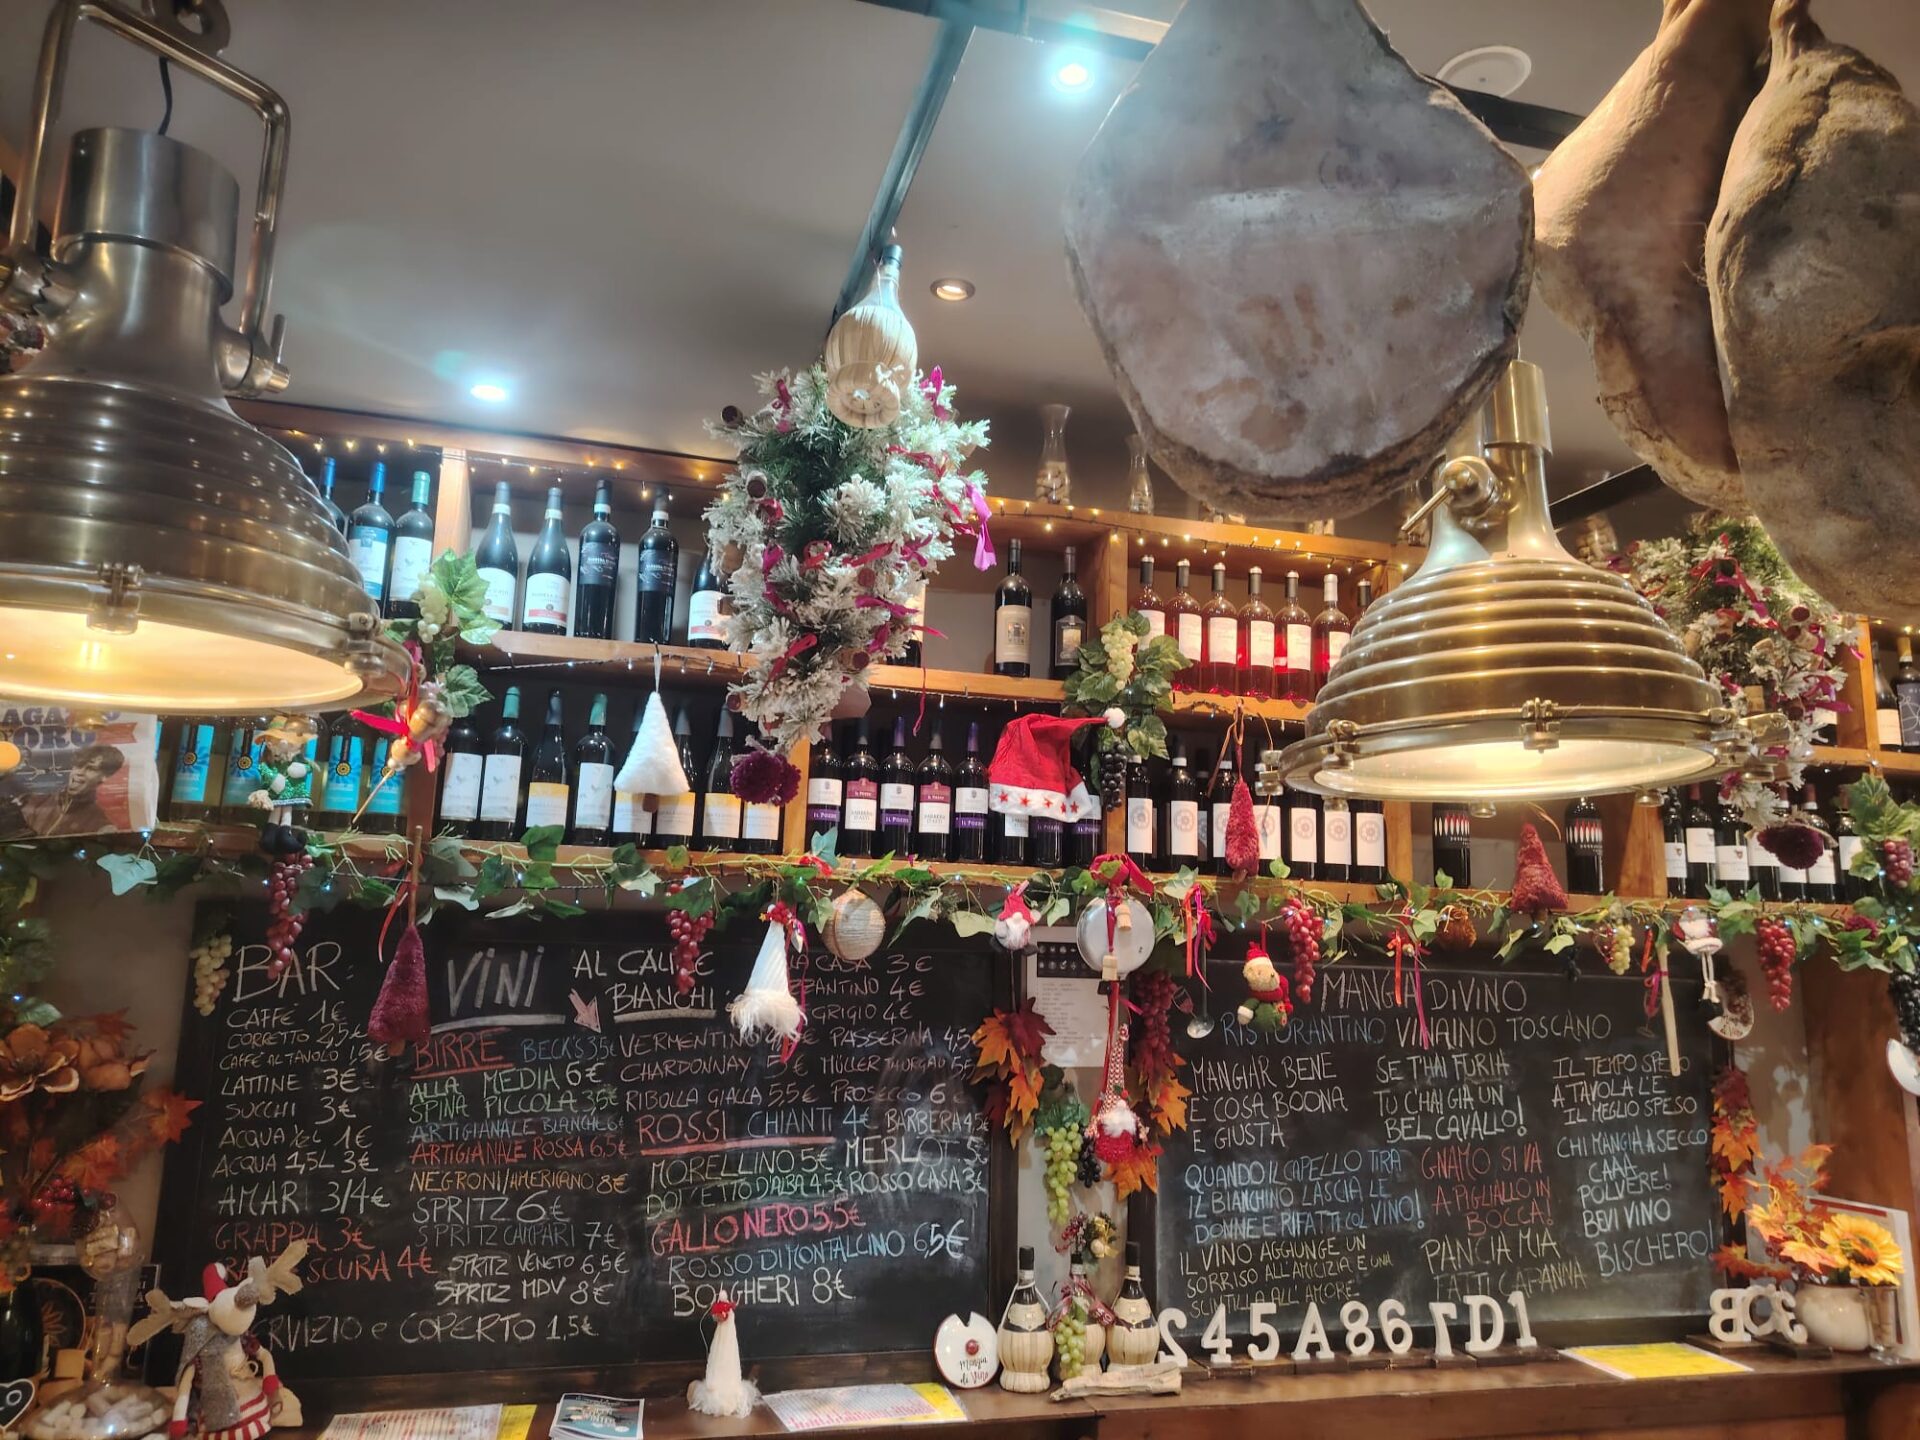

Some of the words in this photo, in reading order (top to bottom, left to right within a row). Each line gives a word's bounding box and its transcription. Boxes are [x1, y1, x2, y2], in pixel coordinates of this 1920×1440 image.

[572, 948, 607, 980] AL
[617, 946, 716, 976] CALIE
[886, 953, 934, 974] 3€
[604, 981, 715, 1014] BIANCHI
[889, 975, 926, 1002] 4€
[1320, 968, 1418, 1013] MANGA
[307, 999, 347, 1024] 1€
[811, 1002, 878, 1026] GRIGIO
[882, 1001, 914, 1026] 4€
[1506, 1008, 1612, 1043] TOSCANO
[227, 1028, 310, 1050] CORRETTO
[412, 1027, 513, 1073] BIRRE
[520, 1036, 585, 1064] BECK'S
[619, 1028, 760, 1059] VERMENTINO
[829, 1020, 934, 1049] PASSERINA
[267, 1053, 284, 1066] AL
[284, 1049, 339, 1066] TAVOLO
[619, 1055, 752, 1083] CHARDONNAY
[1190, 1055, 1278, 1095] MANGIAR
[1280, 1050, 1338, 1089] BENE
[1375, 1055, 1404, 1084] SE
[1451, 1047, 1511, 1081] FURIA
[1552, 1056, 1586, 1080] IL
[1584, 1053, 1638, 1078] TEMPO
[1640, 1050, 1691, 1074] SPEO
[221, 1074, 303, 1096] LATTINE
[321, 1067, 362, 1093] 3€
[408, 1075, 462, 1106] ALLA
[482, 1062, 561, 1099] MEDIA
[564, 1060, 606, 1087] 6€
[830, 1078, 922, 1104] PROSECCO
[1551, 1083, 1565, 1109] A
[1565, 1076, 1635, 1107] TAVOLA
[225, 1100, 297, 1121] SUCCHI
[314, 1095, 358, 1125] 3€
[407, 1092, 470, 1125] SPINA
[482, 1088, 579, 1120] PICCOLA
[626, 1086, 701, 1113] RIBOLLA
[707, 1085, 763, 1110] GIALLA
[1213, 1091, 1270, 1122] COSA
[1272, 1085, 1349, 1119] BOONA
[1373, 1088, 1398, 1118] TU
[1478, 1083, 1505, 1107] UN
[1563, 1106, 1588, 1126] IL
[1591, 1099, 1640, 1124] MEGLIO
[1643, 1095, 1698, 1118] SPESO
[408, 1117, 537, 1144] ARTIGIANALE
[635, 1108, 727, 1146] ROSSI
[746, 1106, 834, 1139] CHIANTI
[841, 1103, 880, 1137] 4€
[885, 1106, 963, 1135] BARBERA
[1192, 1129, 1207, 1154] E
[1214, 1117, 1287, 1151] GIUSTA
[1385, 1114, 1433, 1144] BEL
[1435, 1095, 1528, 1142] CAVALLO!
[218, 1125, 286, 1150] ACQUA
[333, 1124, 374, 1150] 1€
[408, 1140, 528, 1167] ARTIGIANALE
[532, 1136, 586, 1162] ROSSA
[1556, 1135, 1588, 1159] CHI
[1591, 1124, 1645, 1157] MANGIA
[1656, 1128, 1709, 1154] SECCO
[211, 1152, 277, 1179] ACQUA
[340, 1149, 380, 1174] 3€
[650, 1149, 796, 1192] MORELLINO
[799, 1146, 834, 1173] 5€
[845, 1133, 961, 1168] MERLOT
[1184, 1160, 1266, 1195] QUANDO
[1268, 1160, 1288, 1185] IL
[1283, 1149, 1363, 1182] CAPELLO
[1367, 1148, 1403, 1175] TIRA
[1420, 1142, 1491, 1182] GNAMO
[1501, 1144, 1519, 1173] SI
[1522, 1140, 1543, 1174] VA
[595, 1173, 630, 1196] 8€
[848, 1169, 915, 1196] ROSSO
[917, 1165, 962, 1192] CASA
[962, 1166, 989, 1195] 3€
[1188, 1194, 1208, 1220] IL
[1211, 1186, 1295, 1215] BIANCHINO
[1301, 1175, 1364, 1207] LASCIA
[1368, 1177, 1392, 1198] LE
[217, 1179, 311, 1217] AMARI
[412, 1195, 511, 1226] SPRITZ
[515, 1189, 572, 1224] 6€
[1431, 1183, 1452, 1217] A
[214, 1220, 328, 1254] GRAPPA
[333, 1216, 376, 1252] 3€
[651, 1214, 741, 1257] GALLO
[743, 1204, 811, 1241] NERO
[1195, 1216, 1262, 1245] DONNE
[1261, 1214, 1278, 1237] E
[1280, 1208, 1341, 1239] RIFATTI
[1345, 1207, 1368, 1231] COL
[1582, 1206, 1620, 1239] BEVI
[1623, 1197, 1672, 1230] VINO
[414, 1222, 500, 1248] SPRITZ
[502, 1221, 577, 1248] CAMPARI
[582, 1221, 621, 1251] 7€
[1419, 1230, 1514, 1275] PANCIA
[1518, 1226, 1562, 1260] MIA
[306, 1249, 392, 1284] SCURA
[396, 1245, 439, 1280] 4€
[446, 1252, 510, 1277] SPRITZ
[517, 1249, 575, 1274] VENETO
[667, 1253, 755, 1286] ROSSO
[786, 1229, 906, 1272] MONTALCINO
[1179, 1250, 1199, 1277] IL
[1201, 1242, 1254, 1272] VINO
[1260, 1235, 1341, 1263] AGGIUNGE
[1345, 1233, 1367, 1253] UN
[433, 1278, 512, 1307] SPRITZ
[521, 1276, 567, 1300] MDV
[569, 1280, 615, 1306] 8€
[810, 1266, 858, 1305] 8€
[1186, 1267, 1259, 1299] SORRISO
[1356, 1254, 1368, 1271] E
[1369, 1250, 1394, 1268] UNA
[1498, 1254, 1588, 1300] CAPANNA
[1304, 1279, 1361, 1305] AMORE
[399, 1312, 537, 1343] COPERTO
